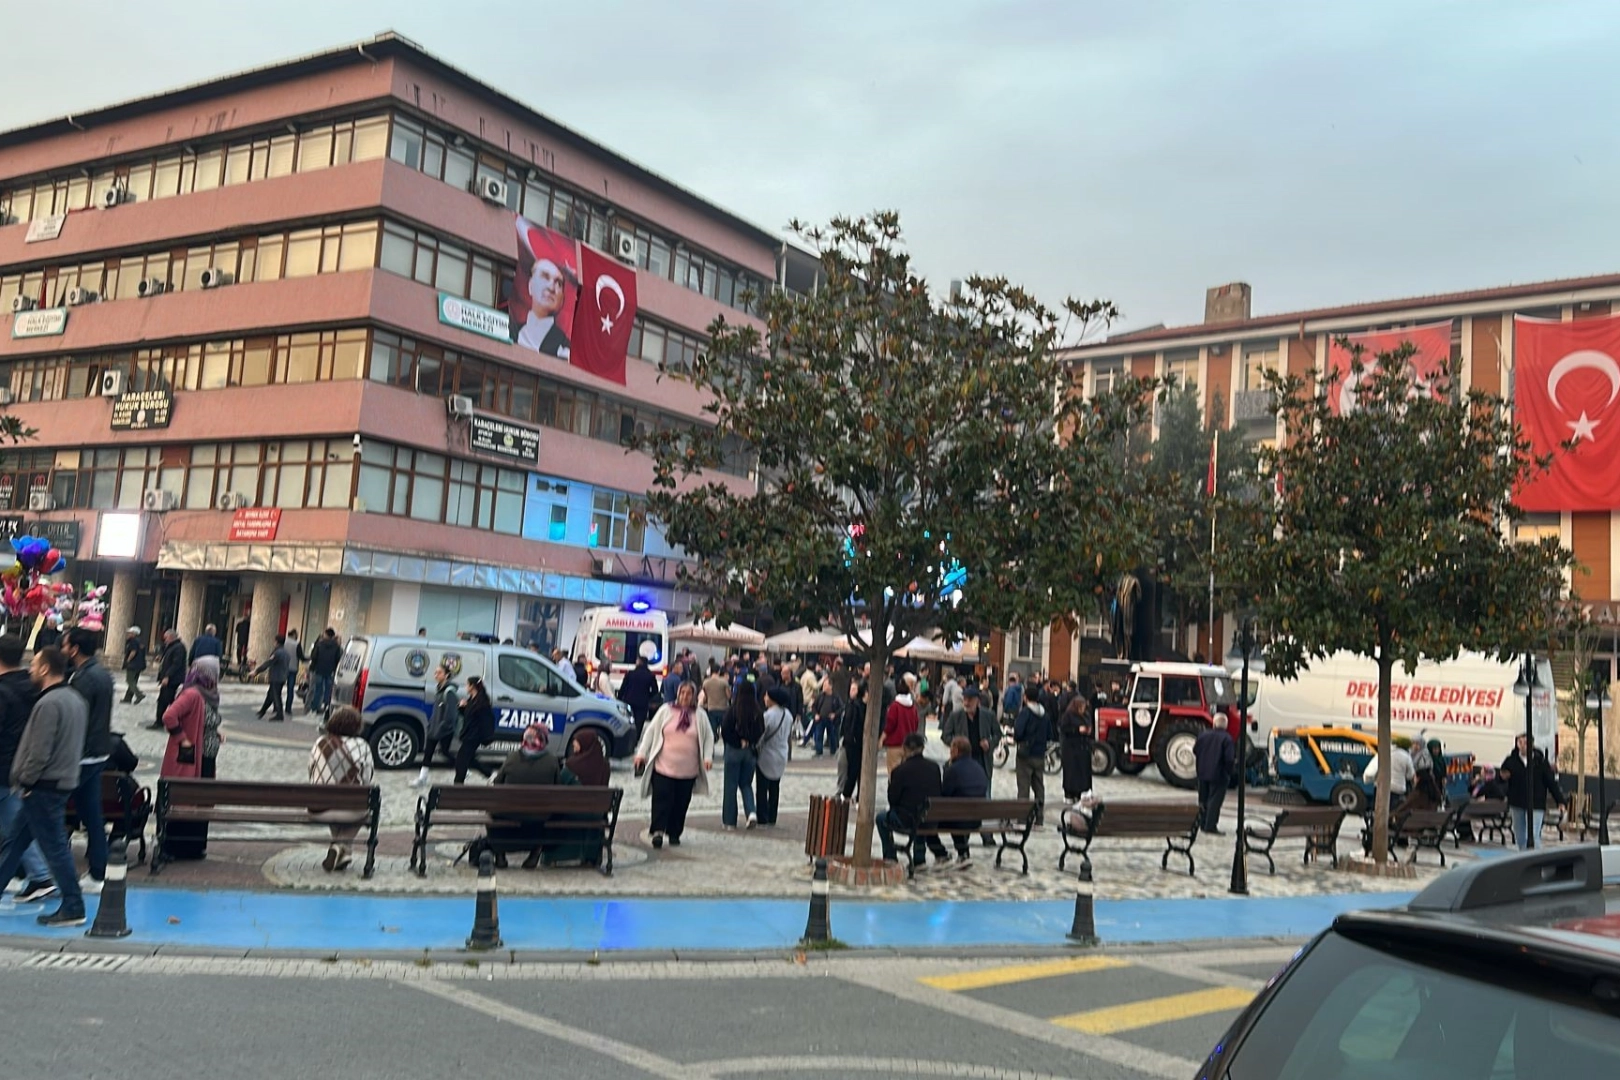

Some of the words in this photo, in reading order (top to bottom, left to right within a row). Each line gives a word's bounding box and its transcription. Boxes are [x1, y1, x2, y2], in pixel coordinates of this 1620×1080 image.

[461, 307, 481, 320] HALK
[115, 401, 139, 411] HUKUK
[606, 618, 654, 629] AMBULANS
[1346, 680, 1408, 700] DEVEK
[1410, 684, 1504, 708] BELEDİYESİ
[1389, 705, 1436, 722] aşıma
